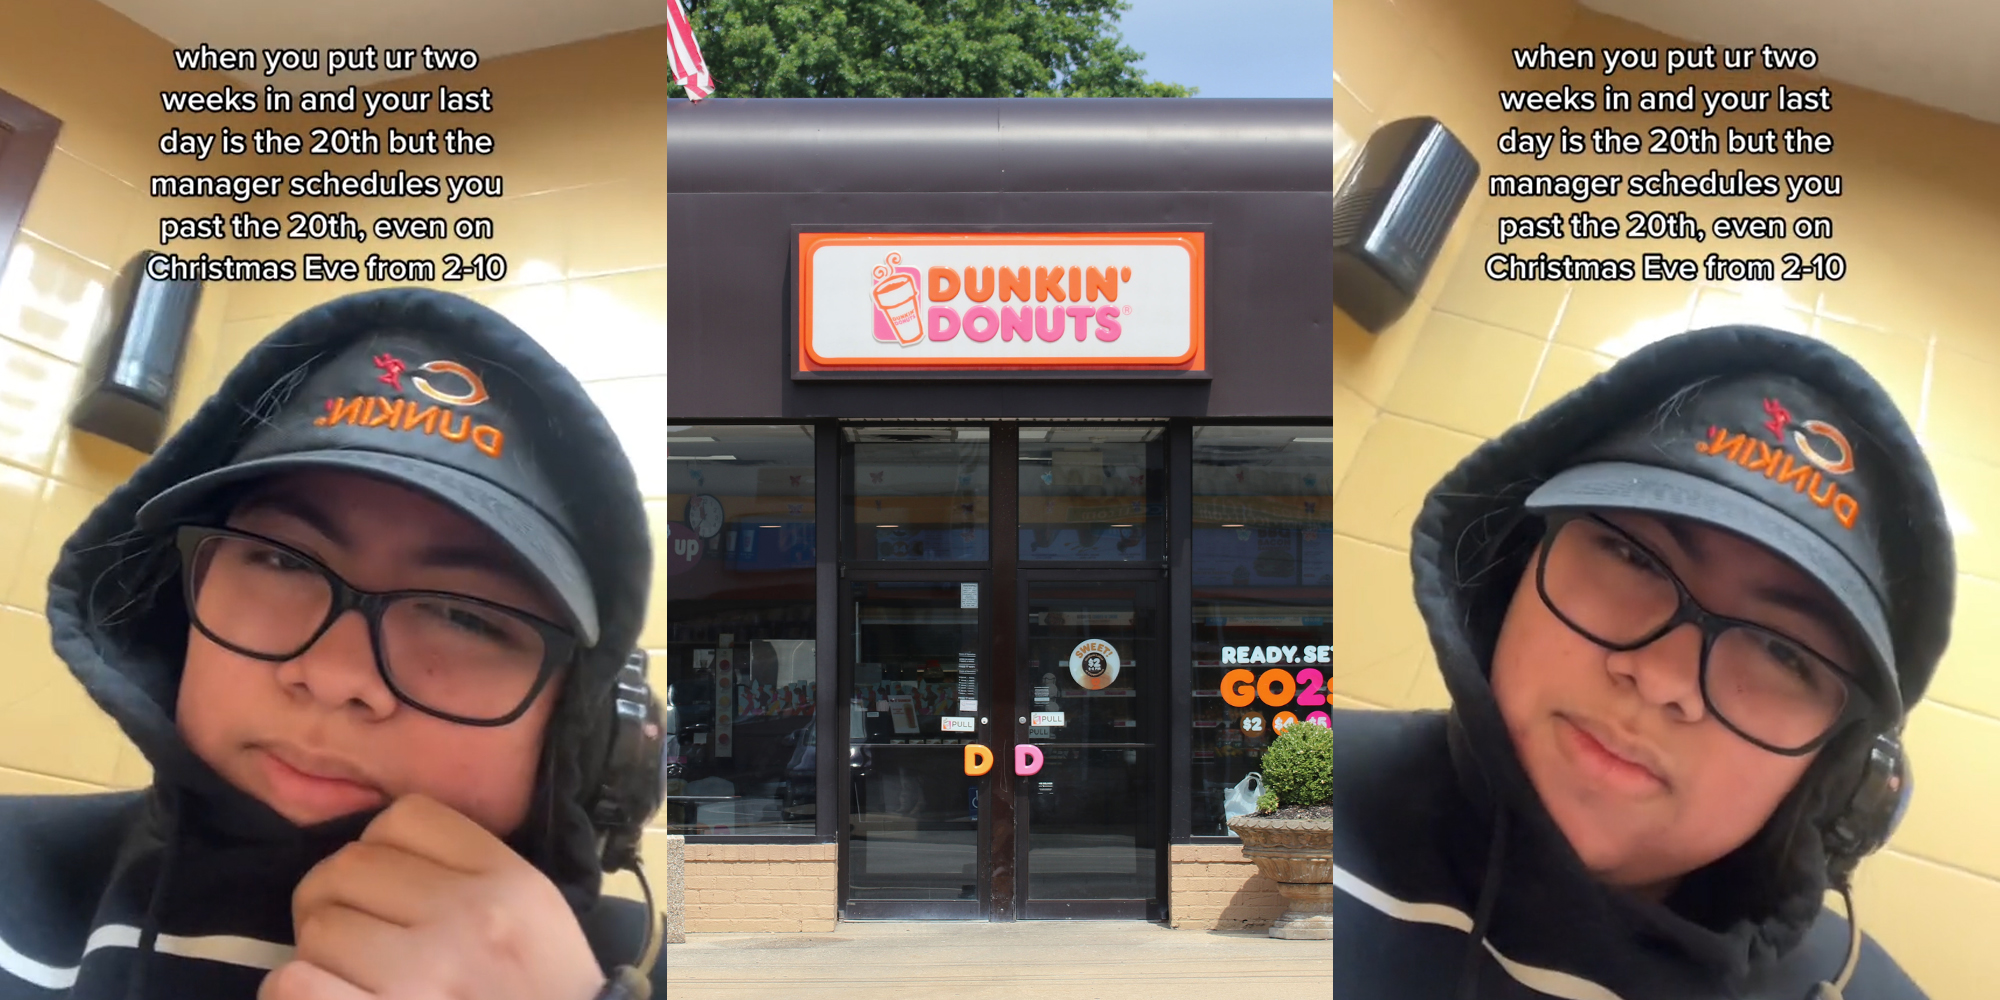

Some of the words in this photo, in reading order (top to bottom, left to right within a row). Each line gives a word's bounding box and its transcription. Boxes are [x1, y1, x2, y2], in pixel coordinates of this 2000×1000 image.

[928, 265, 1131, 302] DUNKIN'
[928, 305, 1122, 342] DONUTS
[674, 539, 699, 562] up
[1075, 643, 1113, 659] SWEET!
[1088, 657, 1101, 668] $2
[1222, 645, 1301, 664] READY.
[1303, 645, 1333, 664] SE
[1220, 668, 1333, 708] GO2
[1242, 717, 1262, 732] $2
[964, 744, 994, 776] D
[1015, 744, 1045, 776] D
